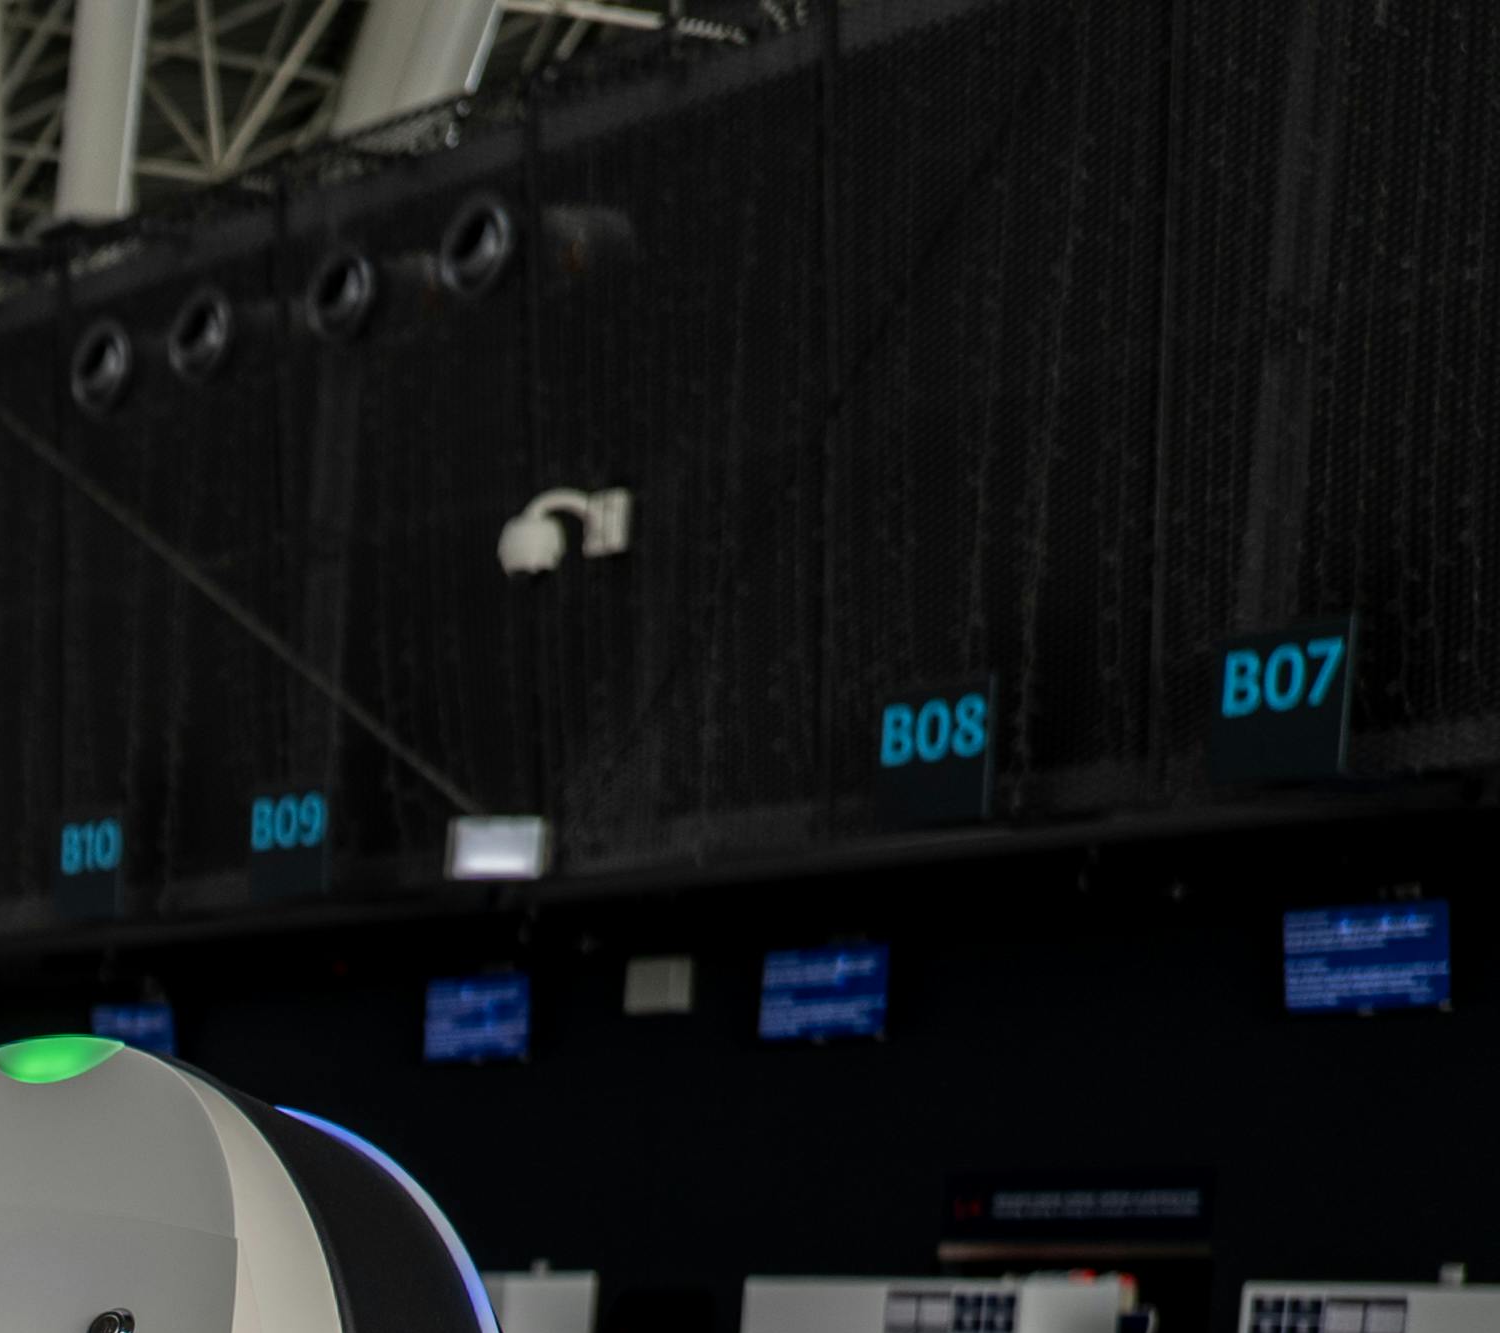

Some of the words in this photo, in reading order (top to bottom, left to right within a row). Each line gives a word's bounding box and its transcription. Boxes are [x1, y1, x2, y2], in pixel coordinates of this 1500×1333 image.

[1221, 635, 1345, 718] B07
[880, 693, 989, 768] B08
[60, 819, 121, 875] B10
[251, 792, 328, 852] B09
